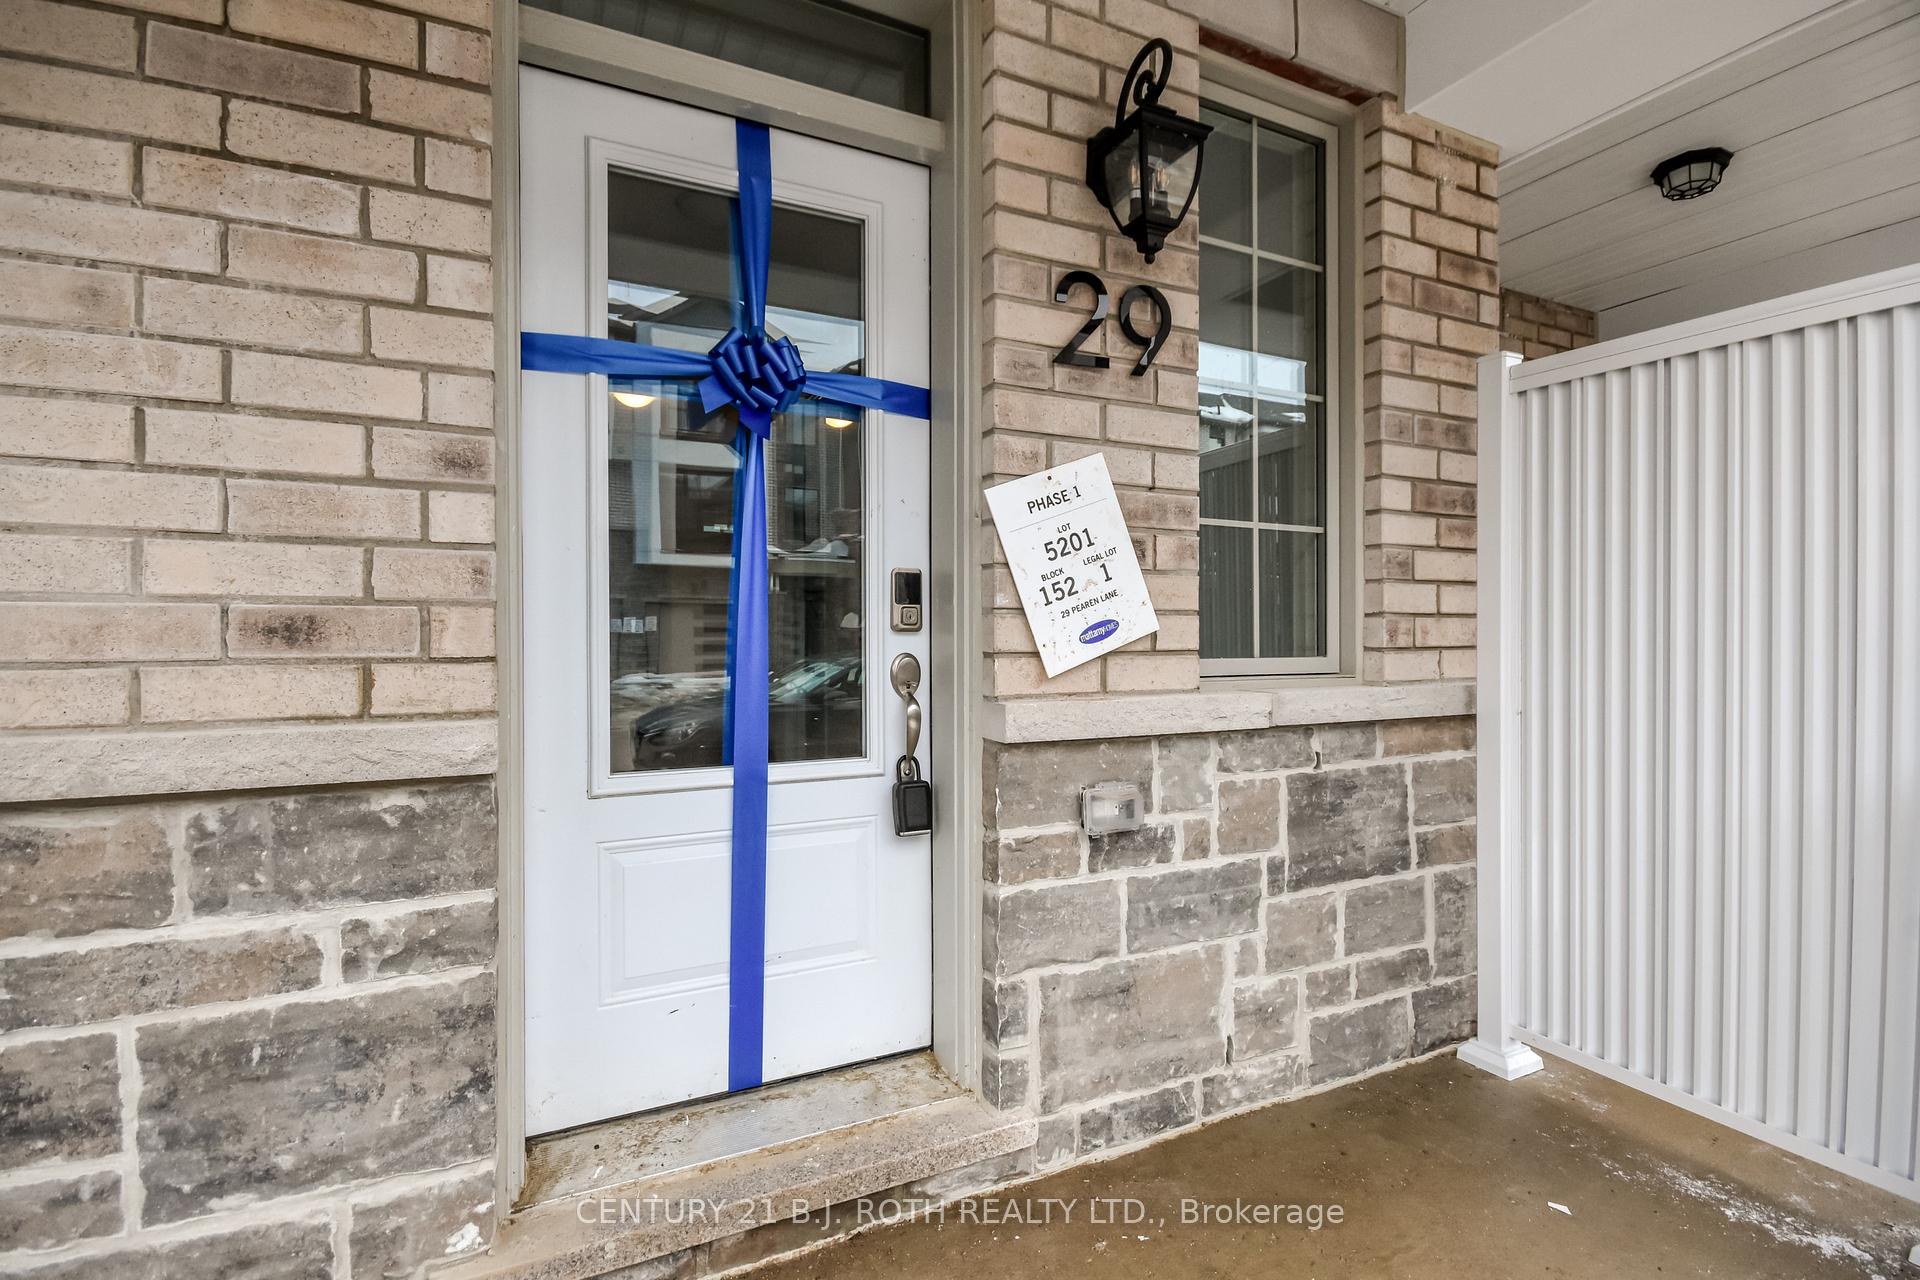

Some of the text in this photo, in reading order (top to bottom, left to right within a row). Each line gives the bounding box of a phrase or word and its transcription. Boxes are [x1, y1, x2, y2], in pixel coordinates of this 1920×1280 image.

[1052, 270, 1172, 377] 29
[1027, 485, 1082, 514] PHASE 1
[1057, 523, 1071, 534] LOT
[1044, 528, 1095, 562] 5201
[1083, 547, 1117, 566] LEGAL LOT
[1041, 568, 1065, 582] BLOCK
[1100, 563, 1112, 582] 1
[1039, 576, 1079, 607] 152
[1060, 589, 1119, 619] 29 PEAREN LANE
